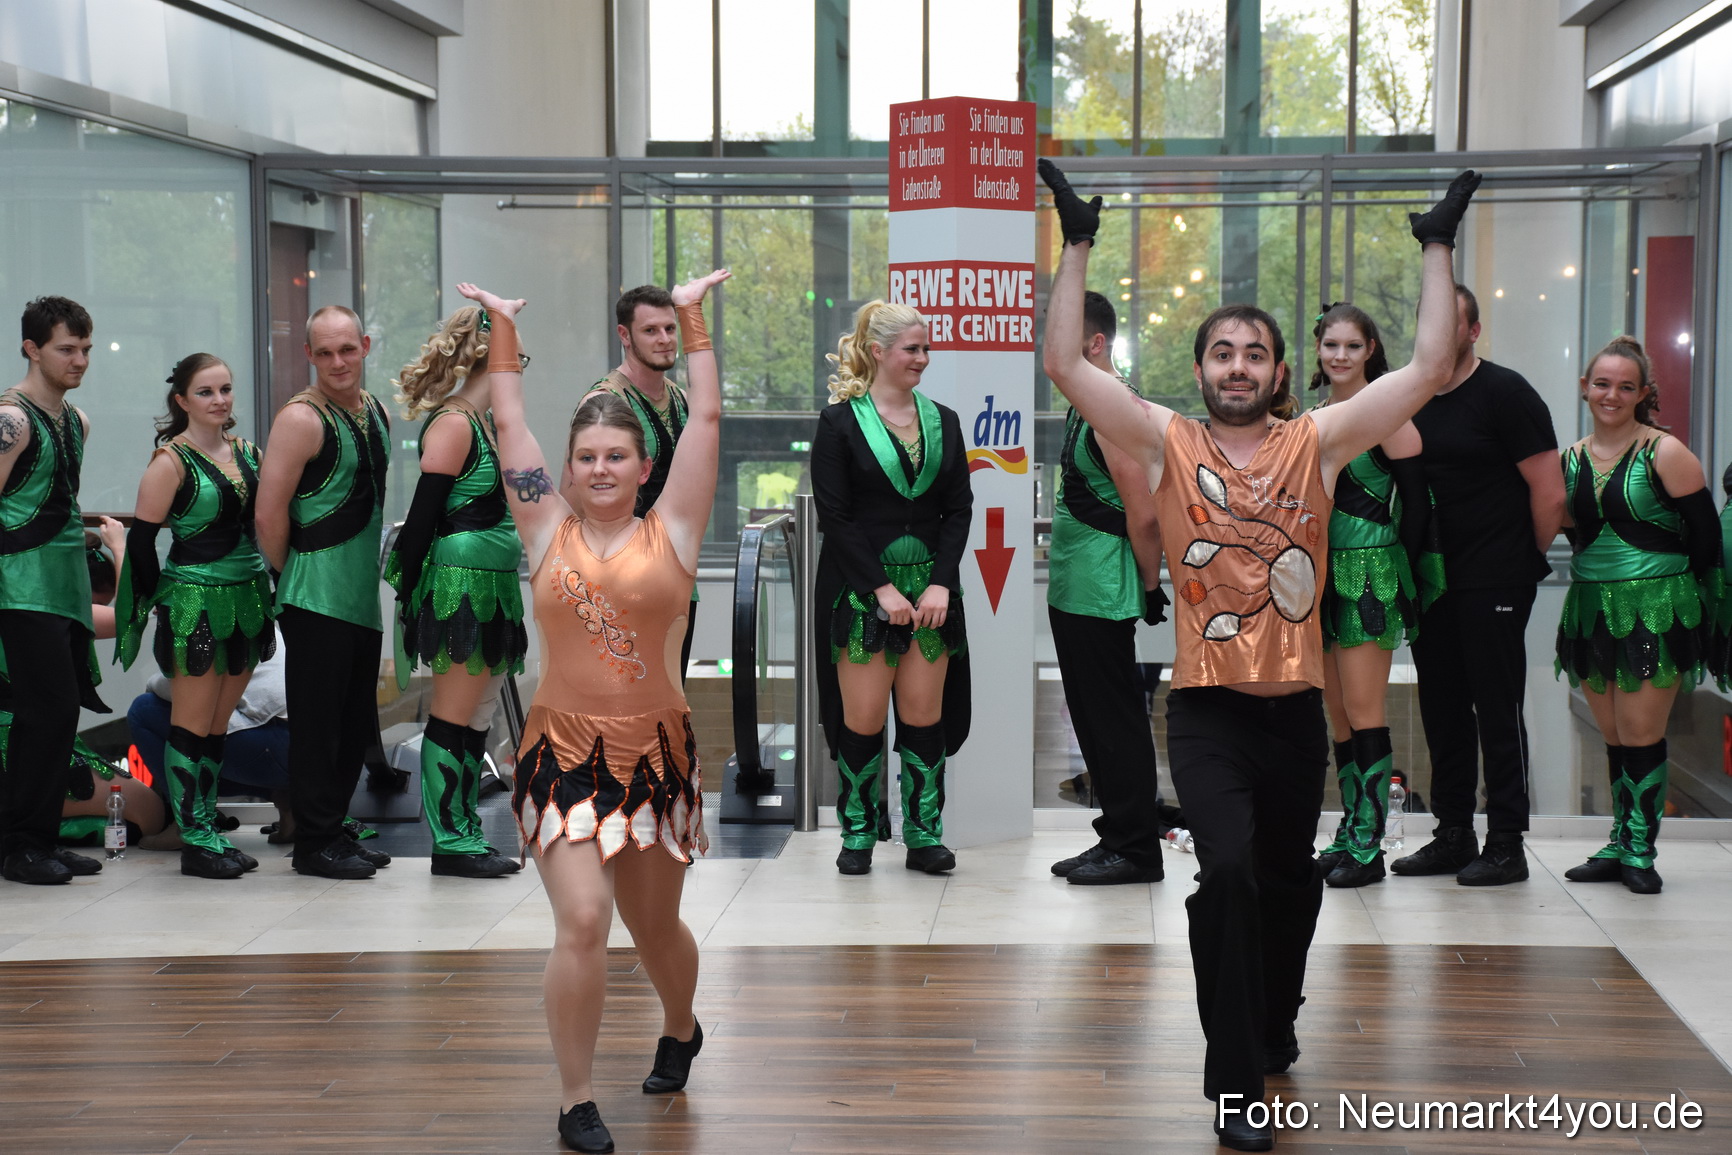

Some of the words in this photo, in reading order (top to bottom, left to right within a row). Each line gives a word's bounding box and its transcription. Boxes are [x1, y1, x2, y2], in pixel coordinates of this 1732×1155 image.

[899, 112, 909, 137] Sie
[910, 110, 931, 136] finden
[933, 113, 945, 133] uns
[969, 107, 981, 132] Sie
[984, 108, 1009, 134] finden
[1010, 116, 1024, 135] uns
[899, 146, 906, 169] in
[907, 144, 918, 168] der
[918, 138, 945, 168] Unteren
[970, 141, 978, 165] in
[980, 141, 993, 166] der
[993, 137, 1024, 168] Unteren
[902, 175, 942, 201] Ladenstraße
[973, 174, 1020, 200] Ladenstraße
[890, 268, 954, 307] REWE
[958, 268, 1033, 308] REWE
[958, 314, 1033, 343] CENTER
[973, 395, 1021, 447] dm
